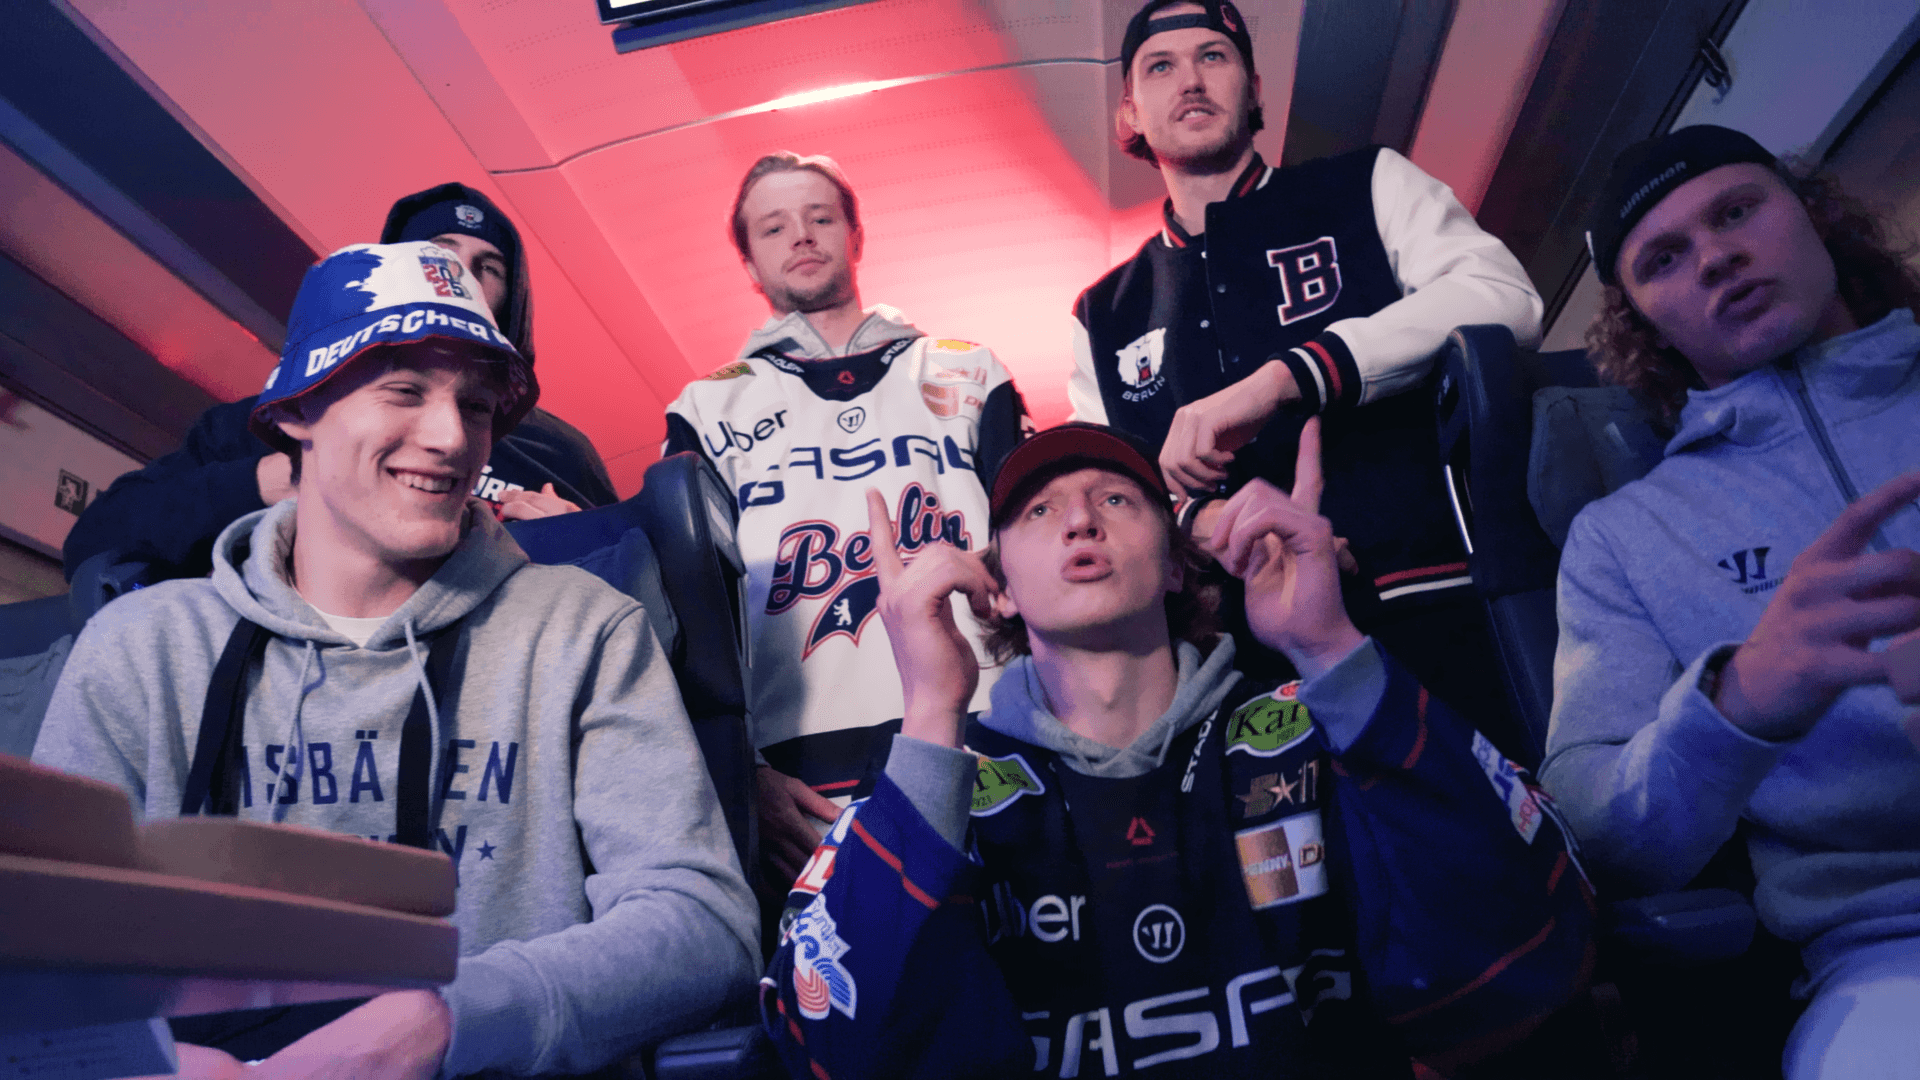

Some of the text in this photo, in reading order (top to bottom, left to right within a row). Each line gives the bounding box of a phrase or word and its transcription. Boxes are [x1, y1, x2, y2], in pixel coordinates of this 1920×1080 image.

[1620, 160, 1687, 219] WARRIOR
[1266, 236, 1342, 326] B
[304, 309, 491, 378] DEUTSCHER
[1121, 375, 1166, 403] BERLIN
[765, 482, 974, 616] Belin
[240, 729, 519, 805] ISBÄEN
